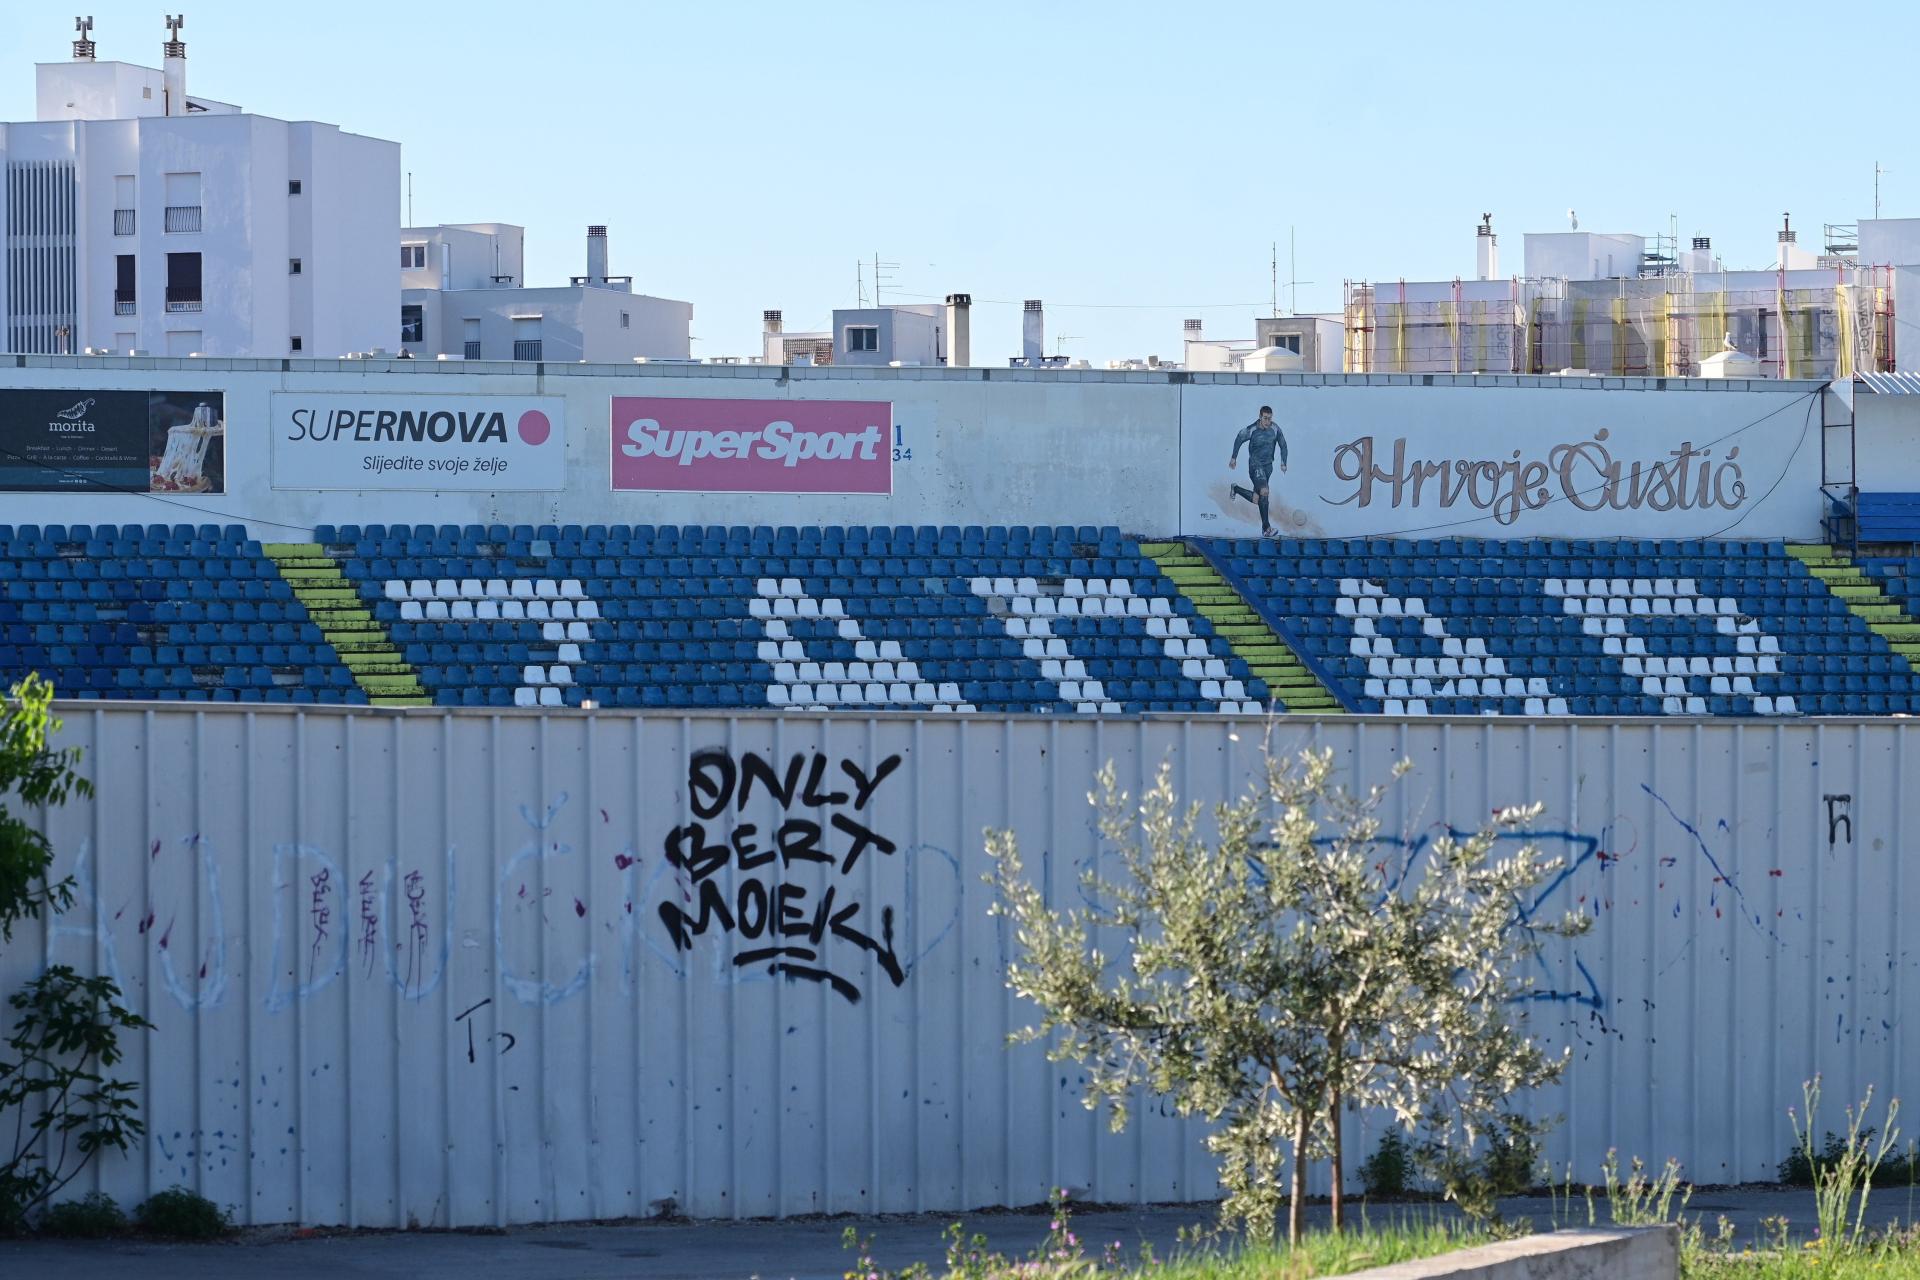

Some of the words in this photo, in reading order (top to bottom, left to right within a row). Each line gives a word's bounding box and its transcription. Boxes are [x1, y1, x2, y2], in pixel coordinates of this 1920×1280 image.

[49, 420, 96, 432] morita
[288, 409, 508, 443] SUPERNOVA
[621, 418, 882, 467] SuperSport
[363, 455, 424, 475] Slijedite
[428, 456, 469, 476] svoje
[473, 456, 508, 476] želje
[1320, 436, 1554, 526] Hrvoje
[688, 746, 902, 820] ONLY
[664, 812, 897, 884] BERT
